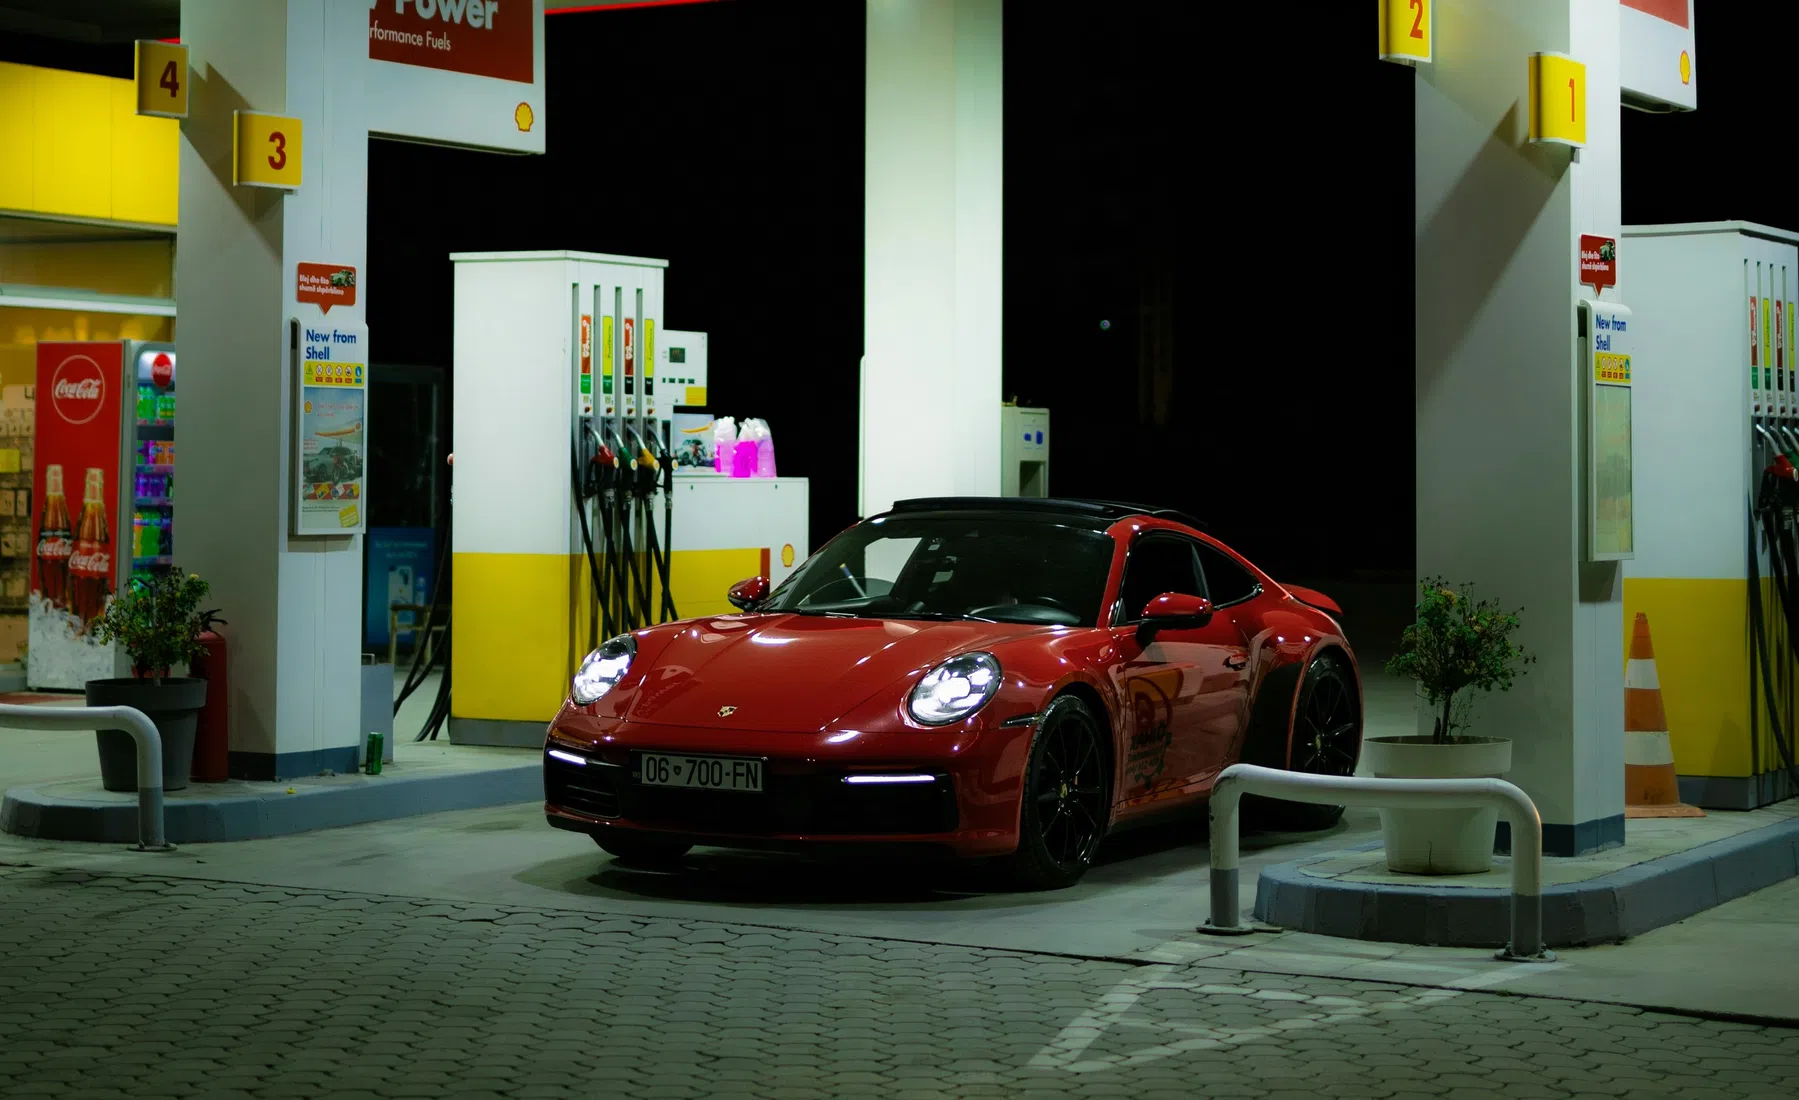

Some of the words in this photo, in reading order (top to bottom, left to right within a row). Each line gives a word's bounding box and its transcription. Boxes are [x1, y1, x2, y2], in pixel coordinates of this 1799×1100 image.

[1409, 0, 1424, 39] 2
[426, 31, 451, 51] Fuels
[159, 60, 180, 98] 4
[1568, 77, 1575, 123] 1
[267, 131, 287, 170] 3
[1595, 313, 1611, 331] New
[1611, 314, 1627, 332] from
[306, 329, 330, 343] New
[333, 329, 357, 344] from
[1595, 335, 1611, 351] Shell
[305, 346, 330, 360] Shell
[646, 756, 670, 783] 06
[685, 759, 759, 789] 700-FN
